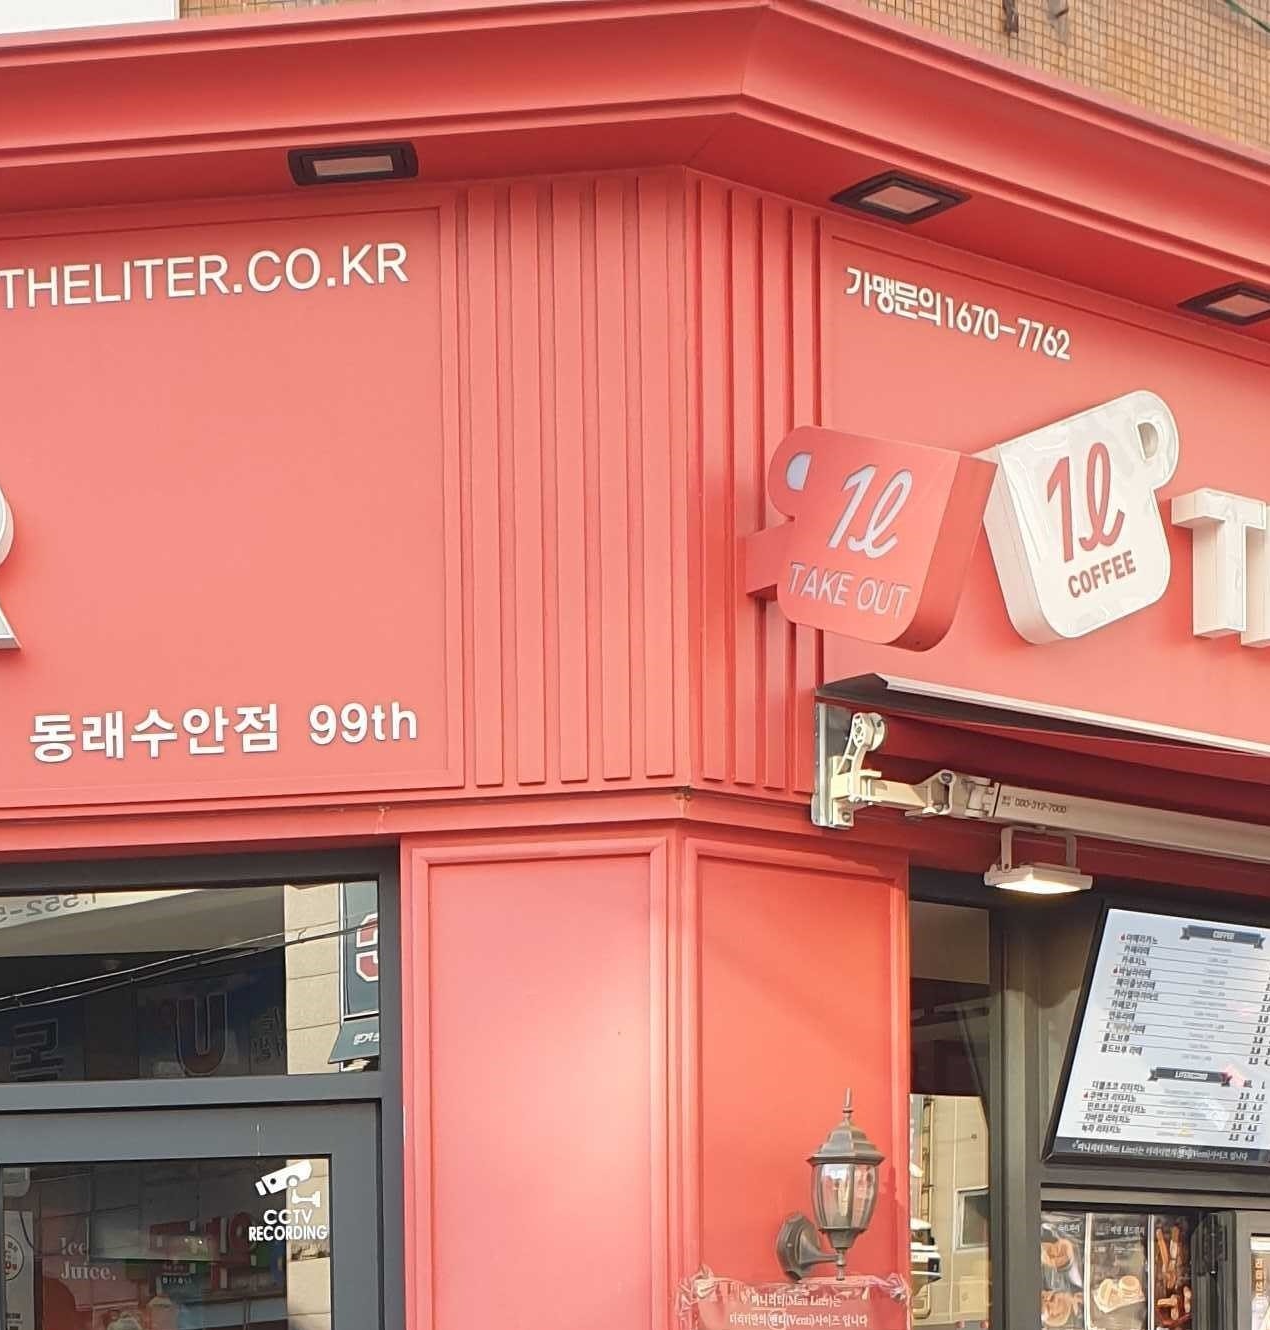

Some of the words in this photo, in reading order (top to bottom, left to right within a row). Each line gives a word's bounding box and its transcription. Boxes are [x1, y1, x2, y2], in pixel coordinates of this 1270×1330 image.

[789, 563, 848, 606] TAKE
[856, 579, 912, 619] OUT
[1067, 550, 1137, 599] COFFEE
[29, 704, 279, 763] 동래수안점
[308, 701, 418, 745] 99th
[248, 1225, 328, 1242] RECORDING
[264, 1209, 313, 1225] CCTV
[60, 1261, 116, 1281] Juice.
